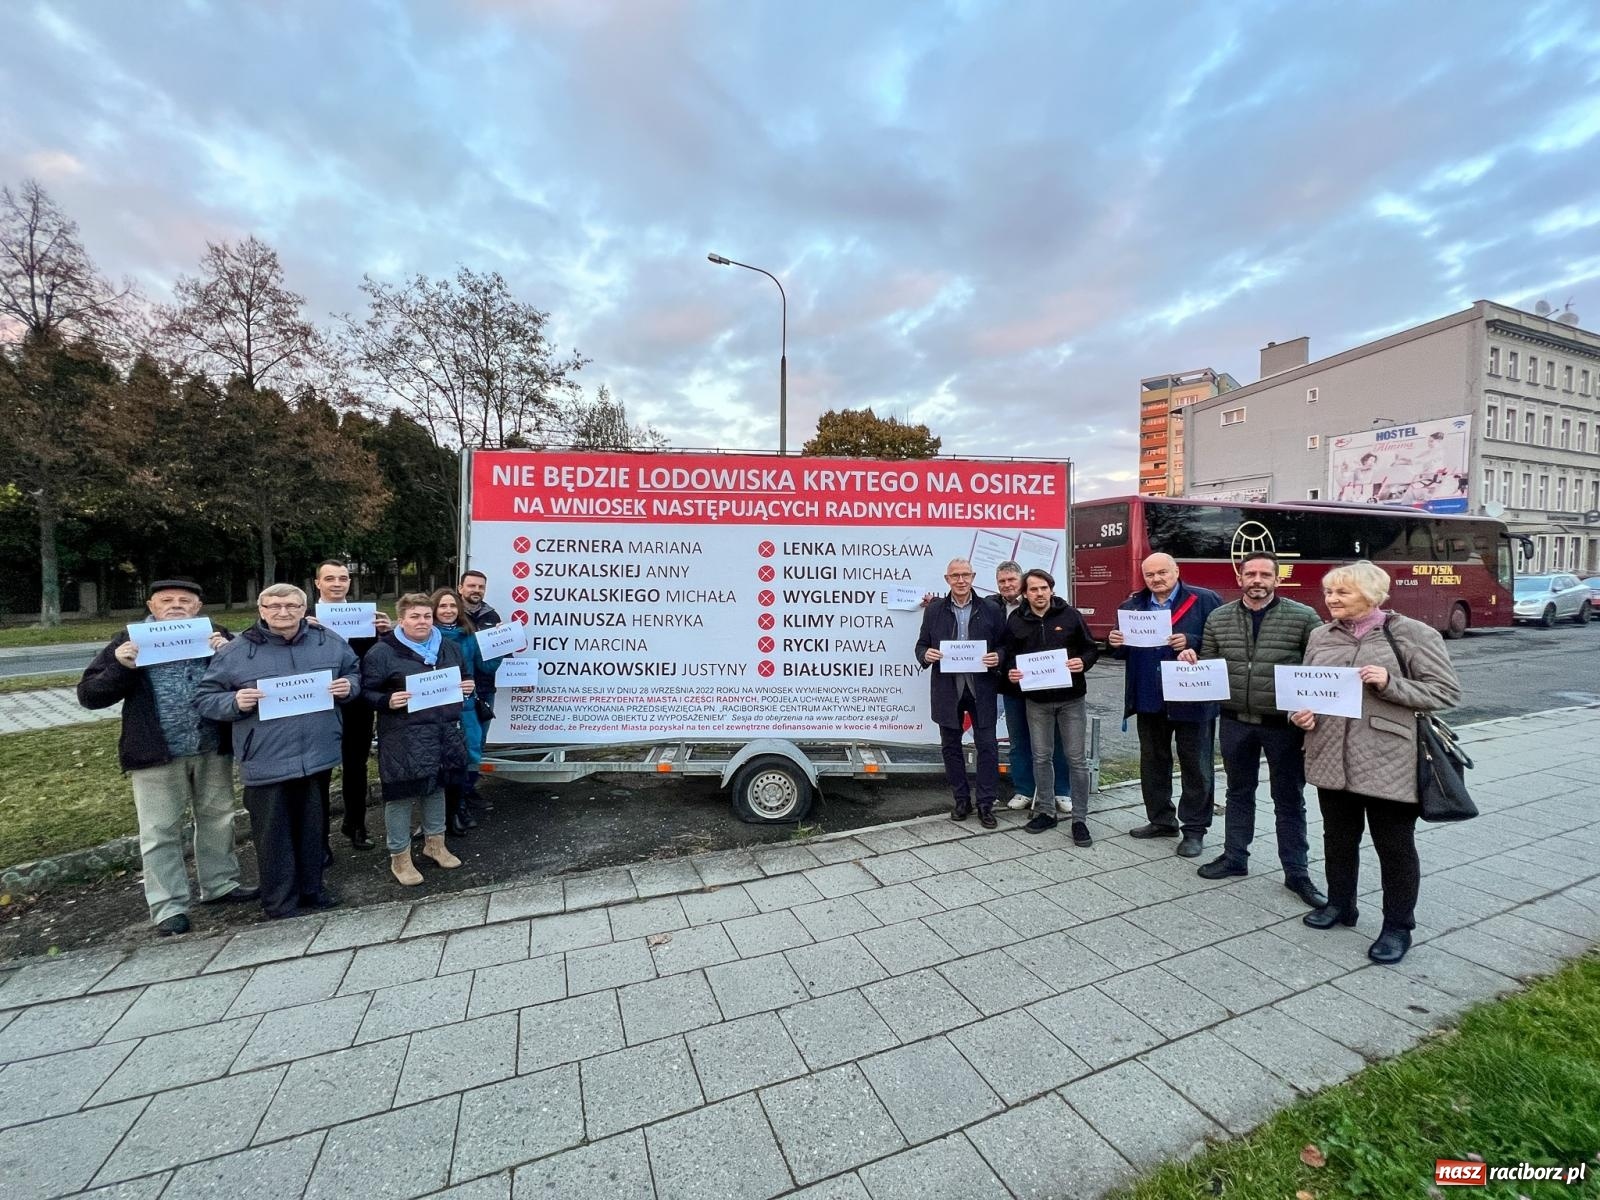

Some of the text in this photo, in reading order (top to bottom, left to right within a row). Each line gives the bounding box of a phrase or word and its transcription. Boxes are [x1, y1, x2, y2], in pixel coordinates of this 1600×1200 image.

[1375, 427, 1419, 441] HOSTEL
[492, 465, 1056, 495] NIE BĘDZIE LODOWISKA KRYTEGO NA OSIRZE
[513, 497, 1036, 521] NA WNIOSEK NASTĘPUJĄCYCH RADNYCH MIEJSKICH:
[1100, 522, 1123, 538] SR5
[535, 538, 703, 554] CZERNERA MARIANA
[783, 541, 934, 557] LENKA MIROSŁAWA
[1354, 541, 1360, 554] 5
[534, 563, 690, 578] SZUKALSKIEJ ANNY
[783, 566, 912, 581] KULIGI MICHAŁA
[534, 588, 737, 603] SZUKALSKIEGO MICHAŁA
[783, 590, 876, 604] WYGLENDY
[534, 612, 704, 627] MAINUSZA HENRYKA
[783, 614, 894, 629] KLIMY PIOTRA
[533, 637, 648, 652] FICY MARCINA
[783, 638, 887, 653] RYCKI PAWŁA
[682, 663, 748, 677] JUSTYNY
[783, 662, 923, 677] BIAŁUSKIEJ IRENY
[1294, 672, 1341, 680] POLOWY
[511, 696, 534, 704] PRZY
[536, 696, 587, 704] SPRZECIWIE
[590, 696, 645, 704] PREZYDENTA
[646, 696, 678, 704] MIASTA
[684, 696, 714, 704] CZĘŚCI
[842, 696, 850, 704] W
[852, 696, 888, 704] SPRAWIE
[510, 704, 572, 712] WSTRZYMANIA
[574, 704, 625, 712] WYKONANIA
[780, 704, 820, 712] CENTRUM
[822, 704, 866, 712] AKTYWNEJ
[868, 704, 916, 712] INTEGRACJI
[510, 724, 536, 732] Należy
[568, 724, 577, 732] że
[580, 724, 619, 732] Prezydent
[622, 724, 647, 732] Miasta
[686, 724, 696, 732] na
[698, 724, 710, 732] ten
[712, 724, 724, 732] cel
[726, 724, 770, 732] zewnętrzne
[772, 724, 834, 732] dofinansowanie
[835, 724, 842, 732] w
[844, 724, 870, 732] kwocie
[872, 724, 878, 732] 4
